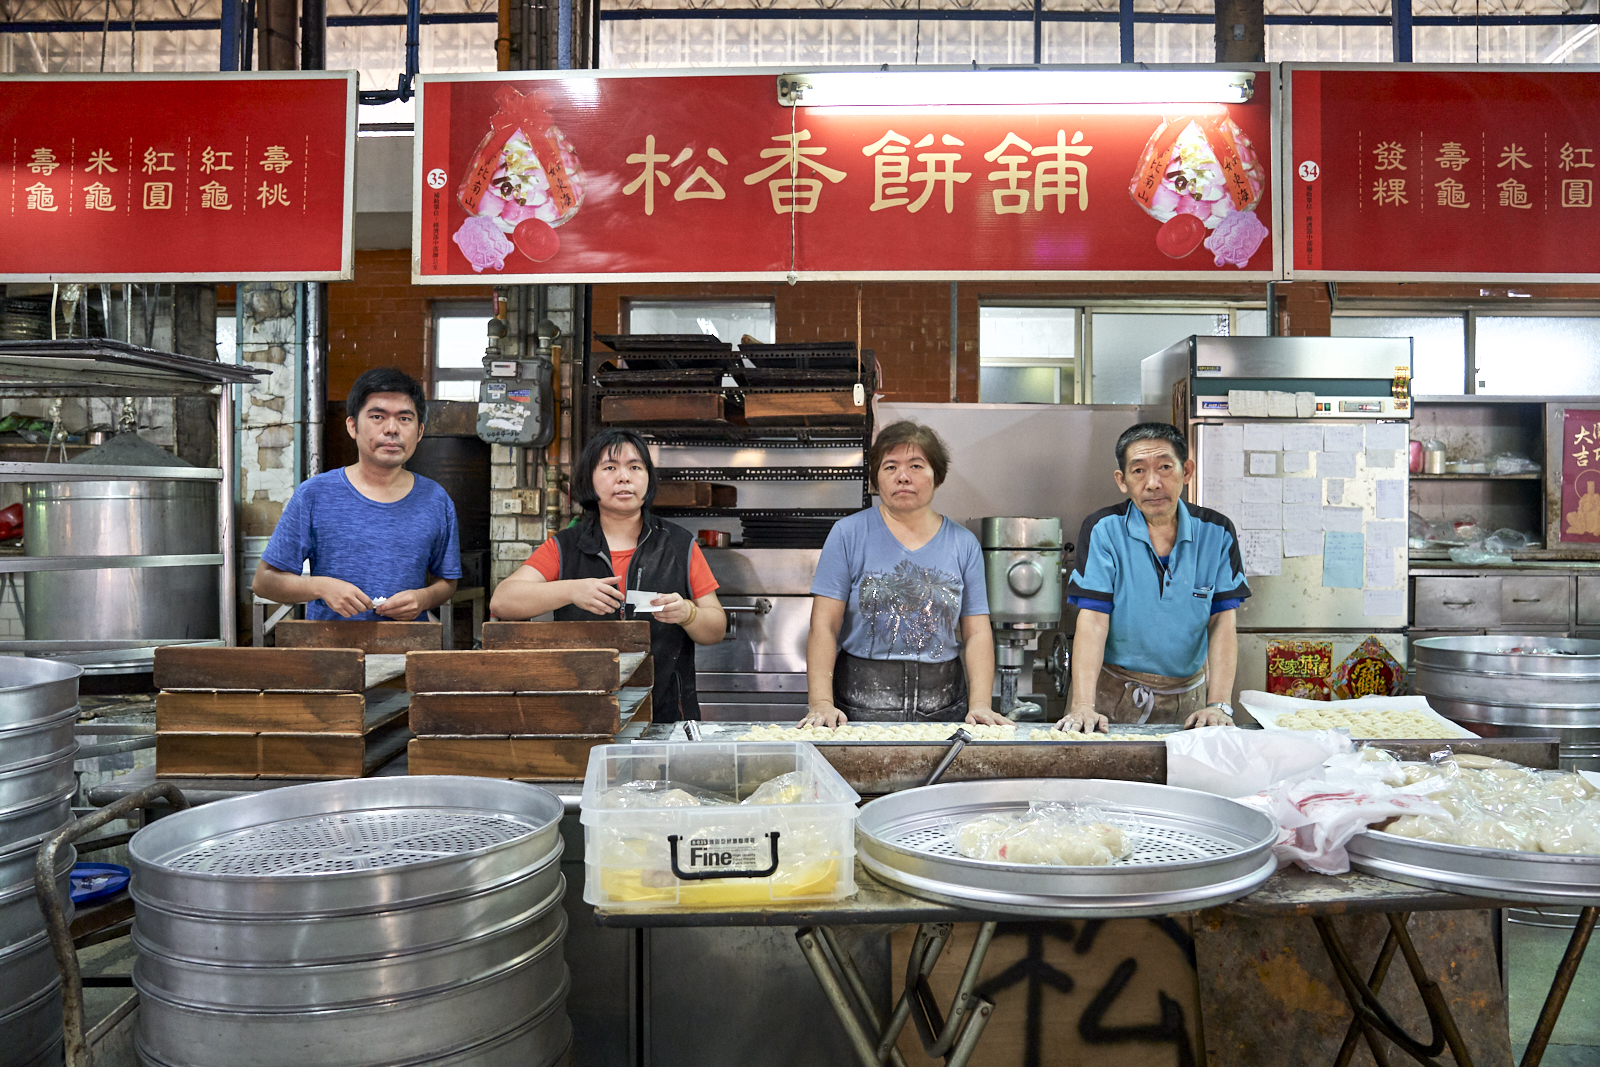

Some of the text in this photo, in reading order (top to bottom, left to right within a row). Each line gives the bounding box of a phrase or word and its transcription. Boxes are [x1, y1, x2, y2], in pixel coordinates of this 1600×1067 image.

[25, 147, 60, 213] 壽龜
[83, 148, 118, 212] 米龜
[142, 146, 176, 210] 紅圓
[199, 145, 234, 211] 紅龜
[257, 144, 293, 209] 壽桃
[429, 172, 446, 186] 35
[622, 129, 1093, 215] 松香餅舖
[1301, 164, 1318, 178] 34
[1372, 141, 1409, 207] 發粿
[1434, 141, 1471, 209] 壽龜
[1496, 142, 1533, 209] 米龜
[1558, 141, 1596, 208] 紅圓
[1572, 425, 1594, 467] 大吉
[691, 847, 732, 867] Fine
